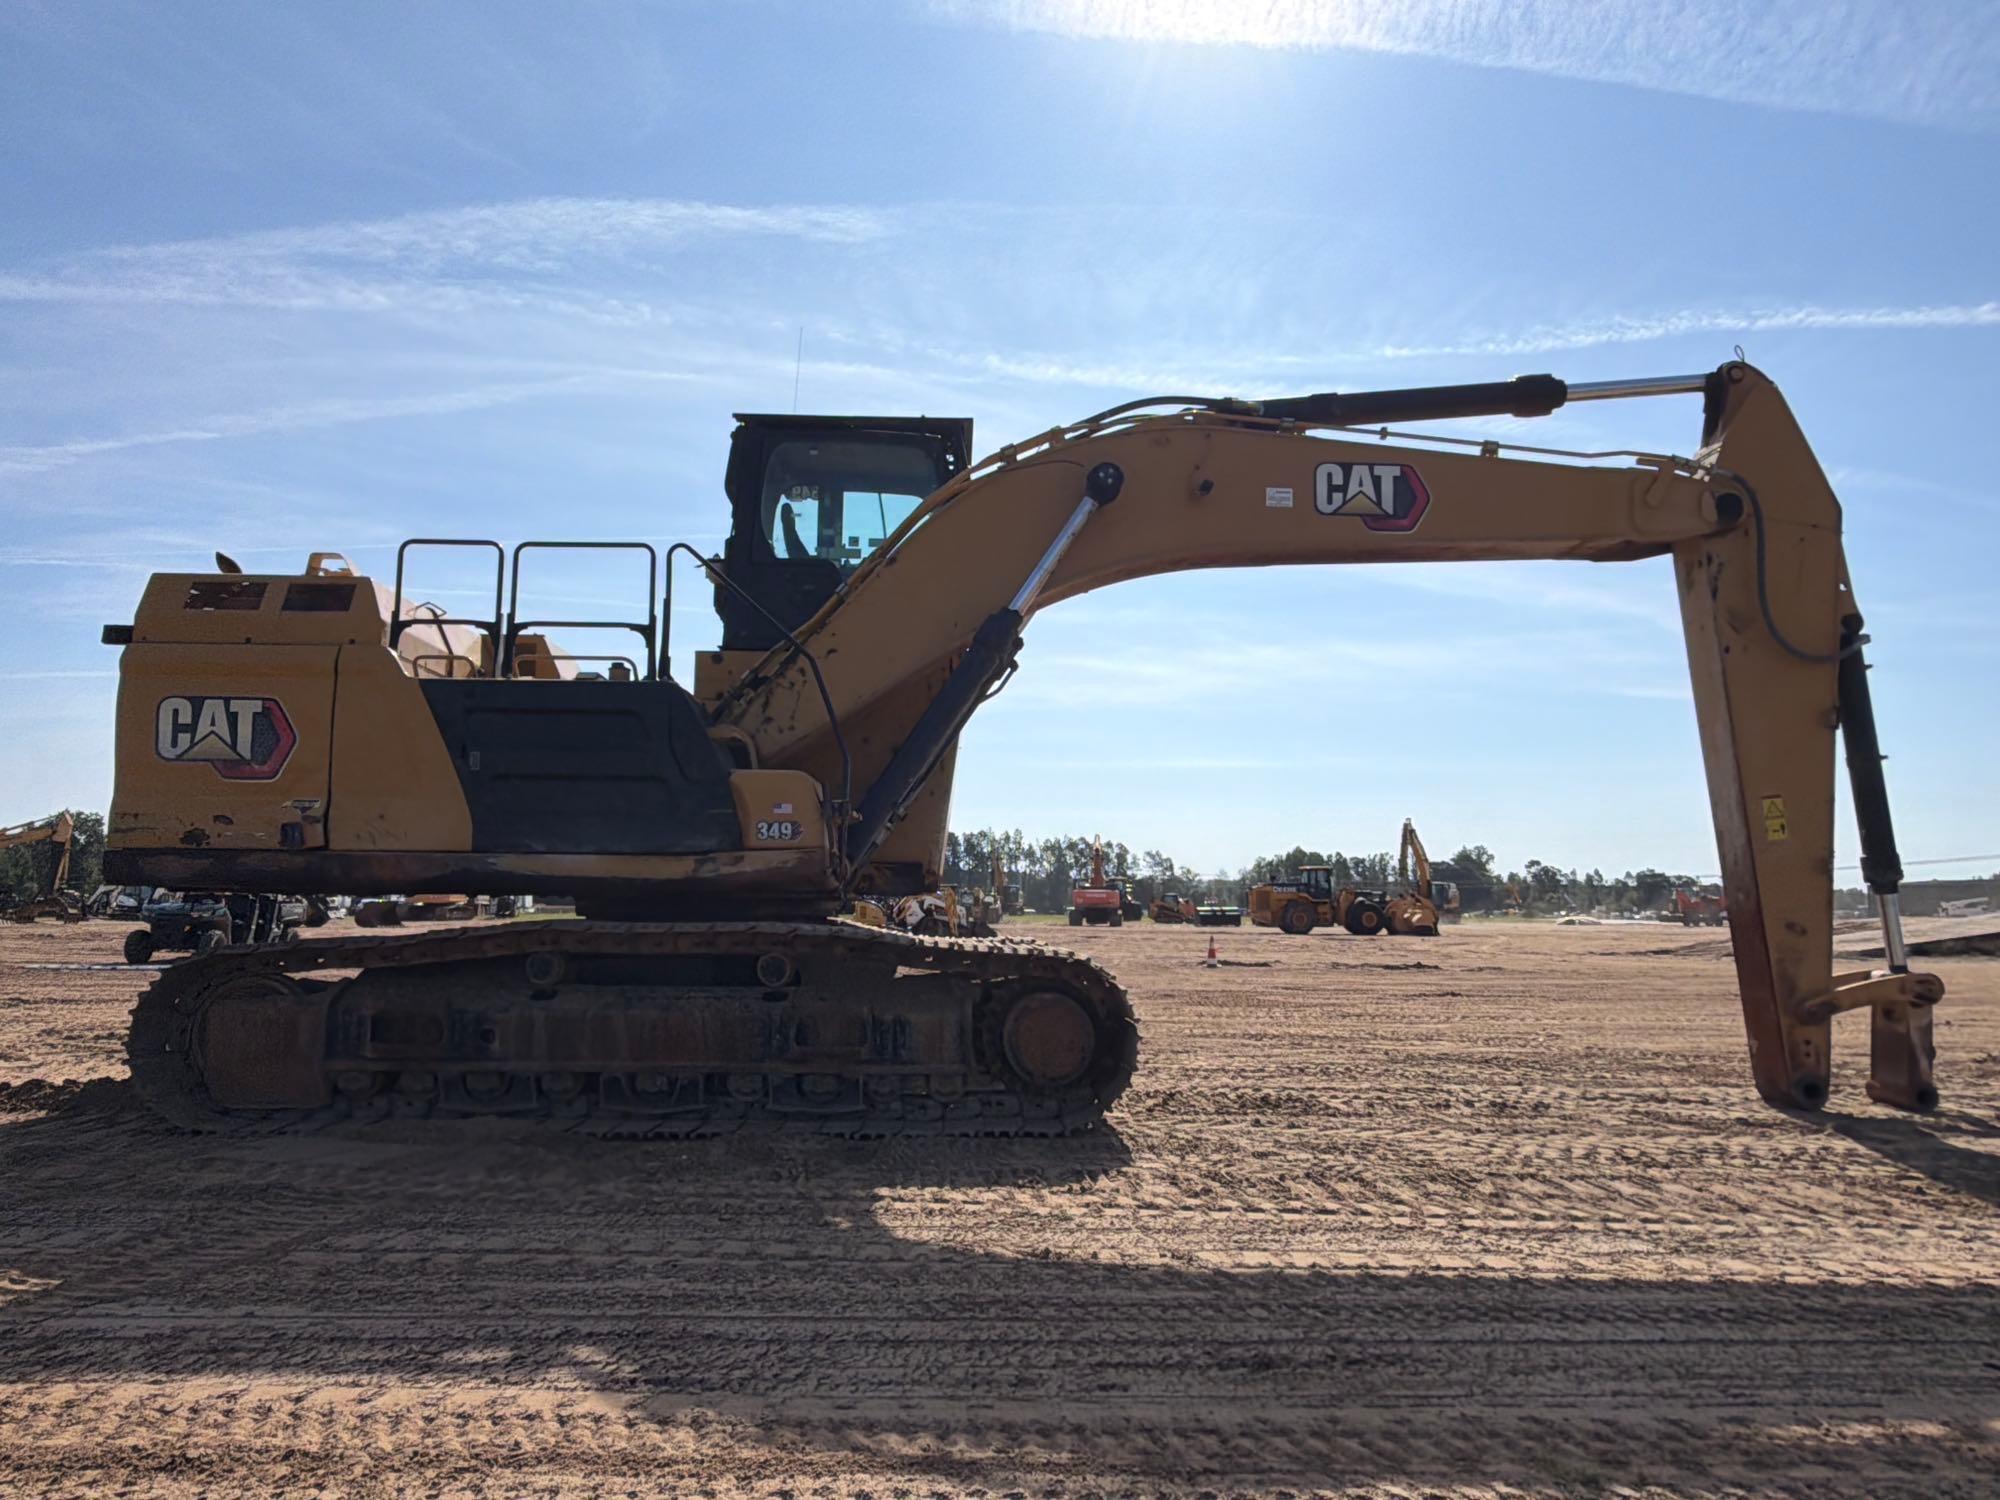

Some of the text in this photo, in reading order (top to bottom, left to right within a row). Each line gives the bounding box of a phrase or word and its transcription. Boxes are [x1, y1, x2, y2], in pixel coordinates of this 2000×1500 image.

[1315, 463, 1401, 516] CAT
[157, 697, 262, 760] CAT
[757, 821, 792, 840] 349
